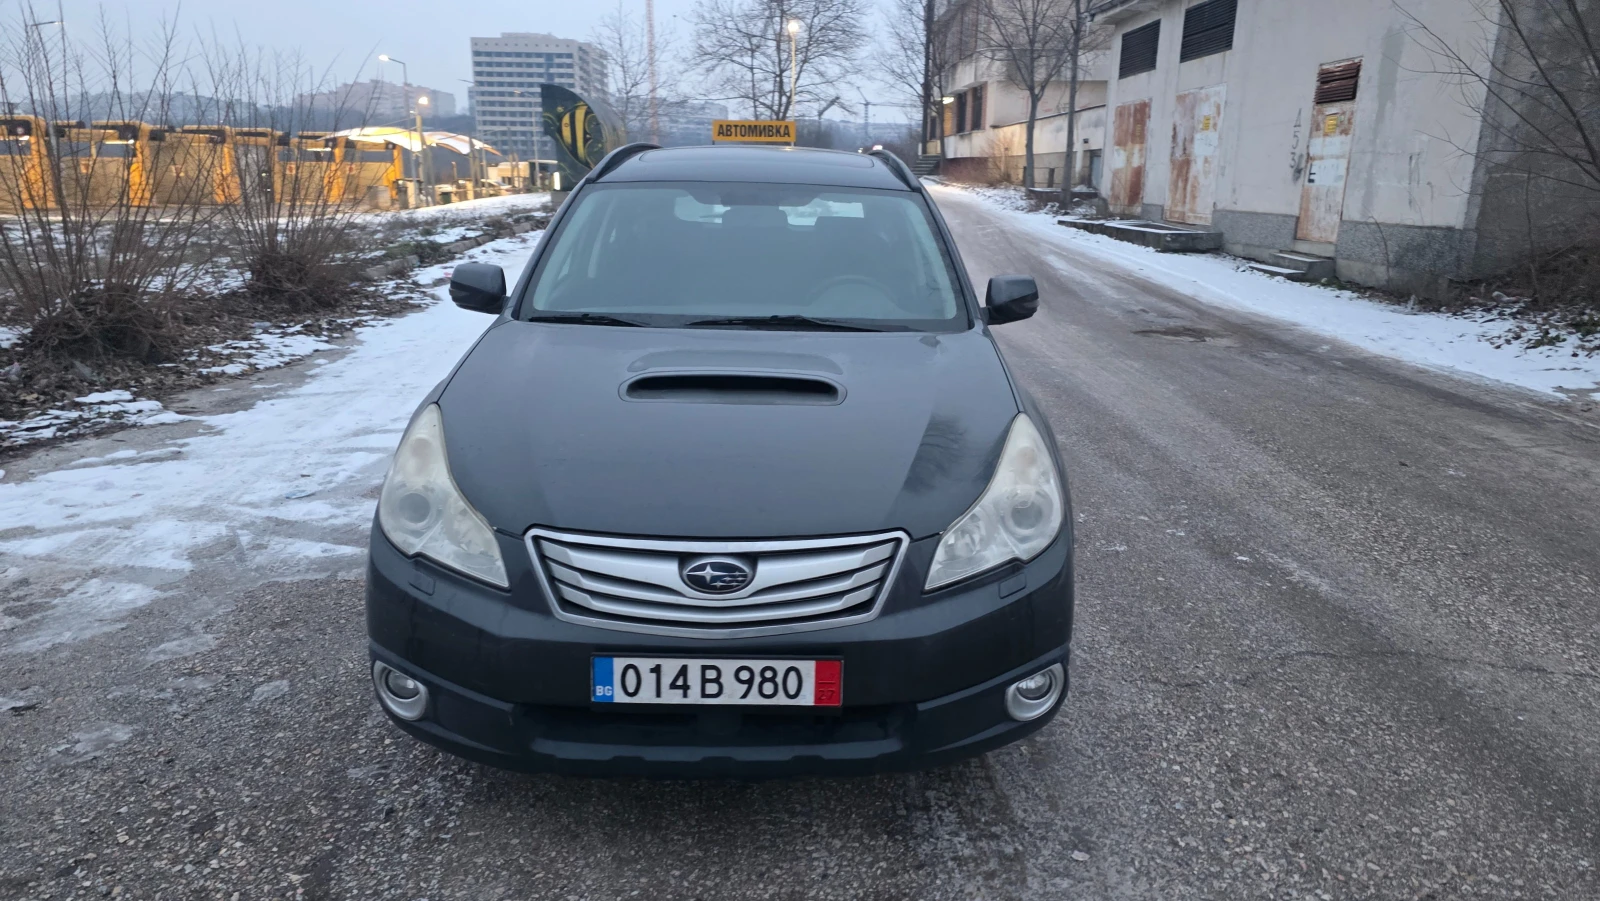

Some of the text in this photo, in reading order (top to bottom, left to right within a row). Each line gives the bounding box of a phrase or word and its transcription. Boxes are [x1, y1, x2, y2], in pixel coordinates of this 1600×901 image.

[717, 124, 791, 138] АВТОМИВКА
[595, 685, 613, 696] BG
[817, 688, 836, 701] 27
